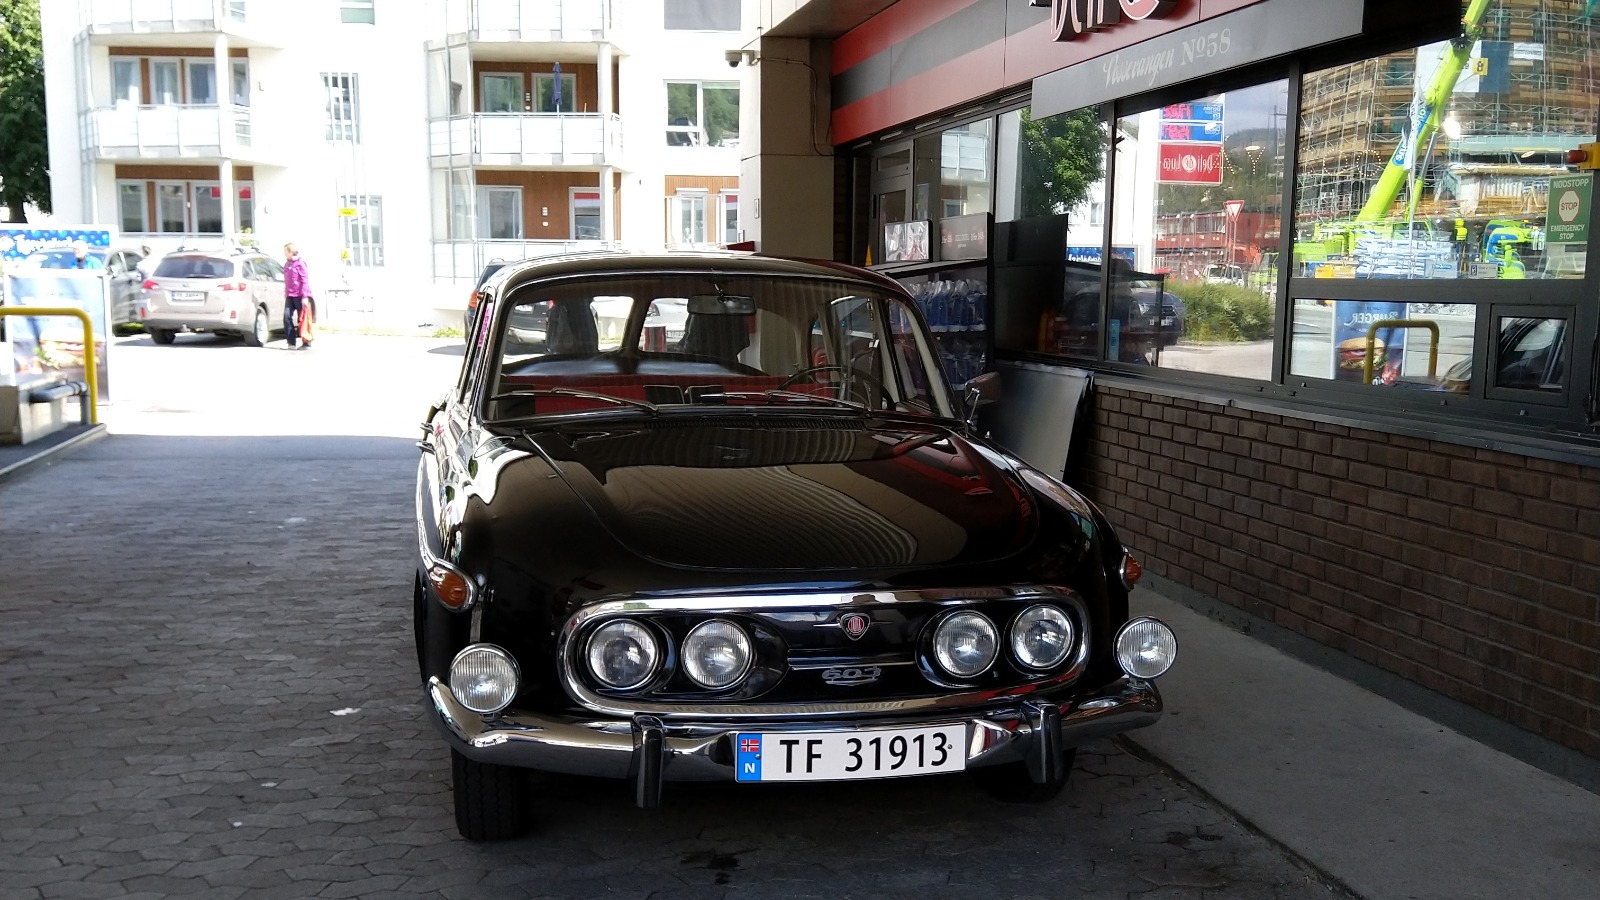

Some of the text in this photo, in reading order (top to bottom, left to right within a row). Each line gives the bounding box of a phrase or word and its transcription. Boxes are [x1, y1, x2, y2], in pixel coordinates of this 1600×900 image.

[1553, 179, 1589, 189] NØDSTOPP
[1561, 202, 1578, 211] STOP
[1551, 224, 1585, 232] EMERGENCY
[1559, 232, 1574, 240] STOP
[821, 667, 882, 680] 603
[744, 732, 948, 774] N TF 31913
